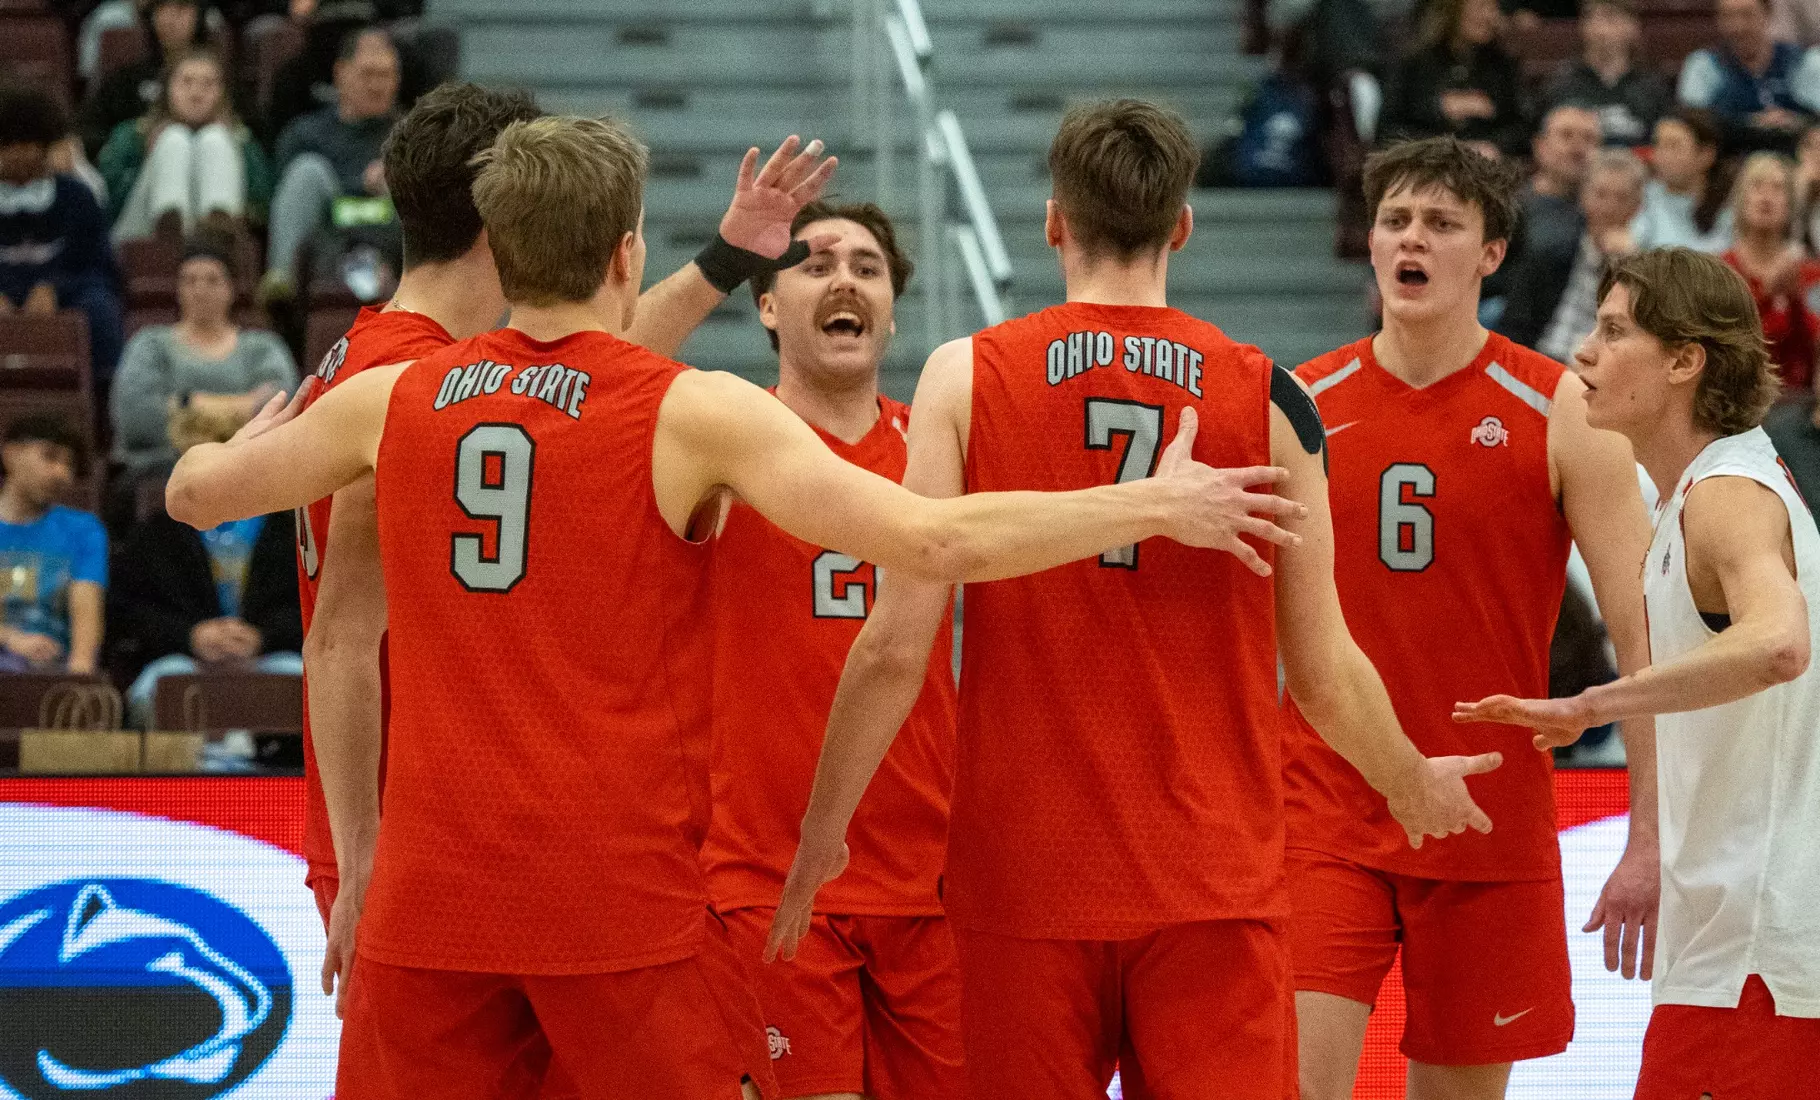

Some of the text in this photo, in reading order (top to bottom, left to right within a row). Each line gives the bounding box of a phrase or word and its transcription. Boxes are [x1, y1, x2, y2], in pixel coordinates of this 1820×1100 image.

[433, 359, 592, 420] OHIO STATE
[1046, 331, 1204, 400] OHIO STATE
[450, 422, 537, 594] 9
[1084, 397, 1165, 571] 7
[1378, 462, 1436, 572] 6
[812, 549, 885, 619] 2
